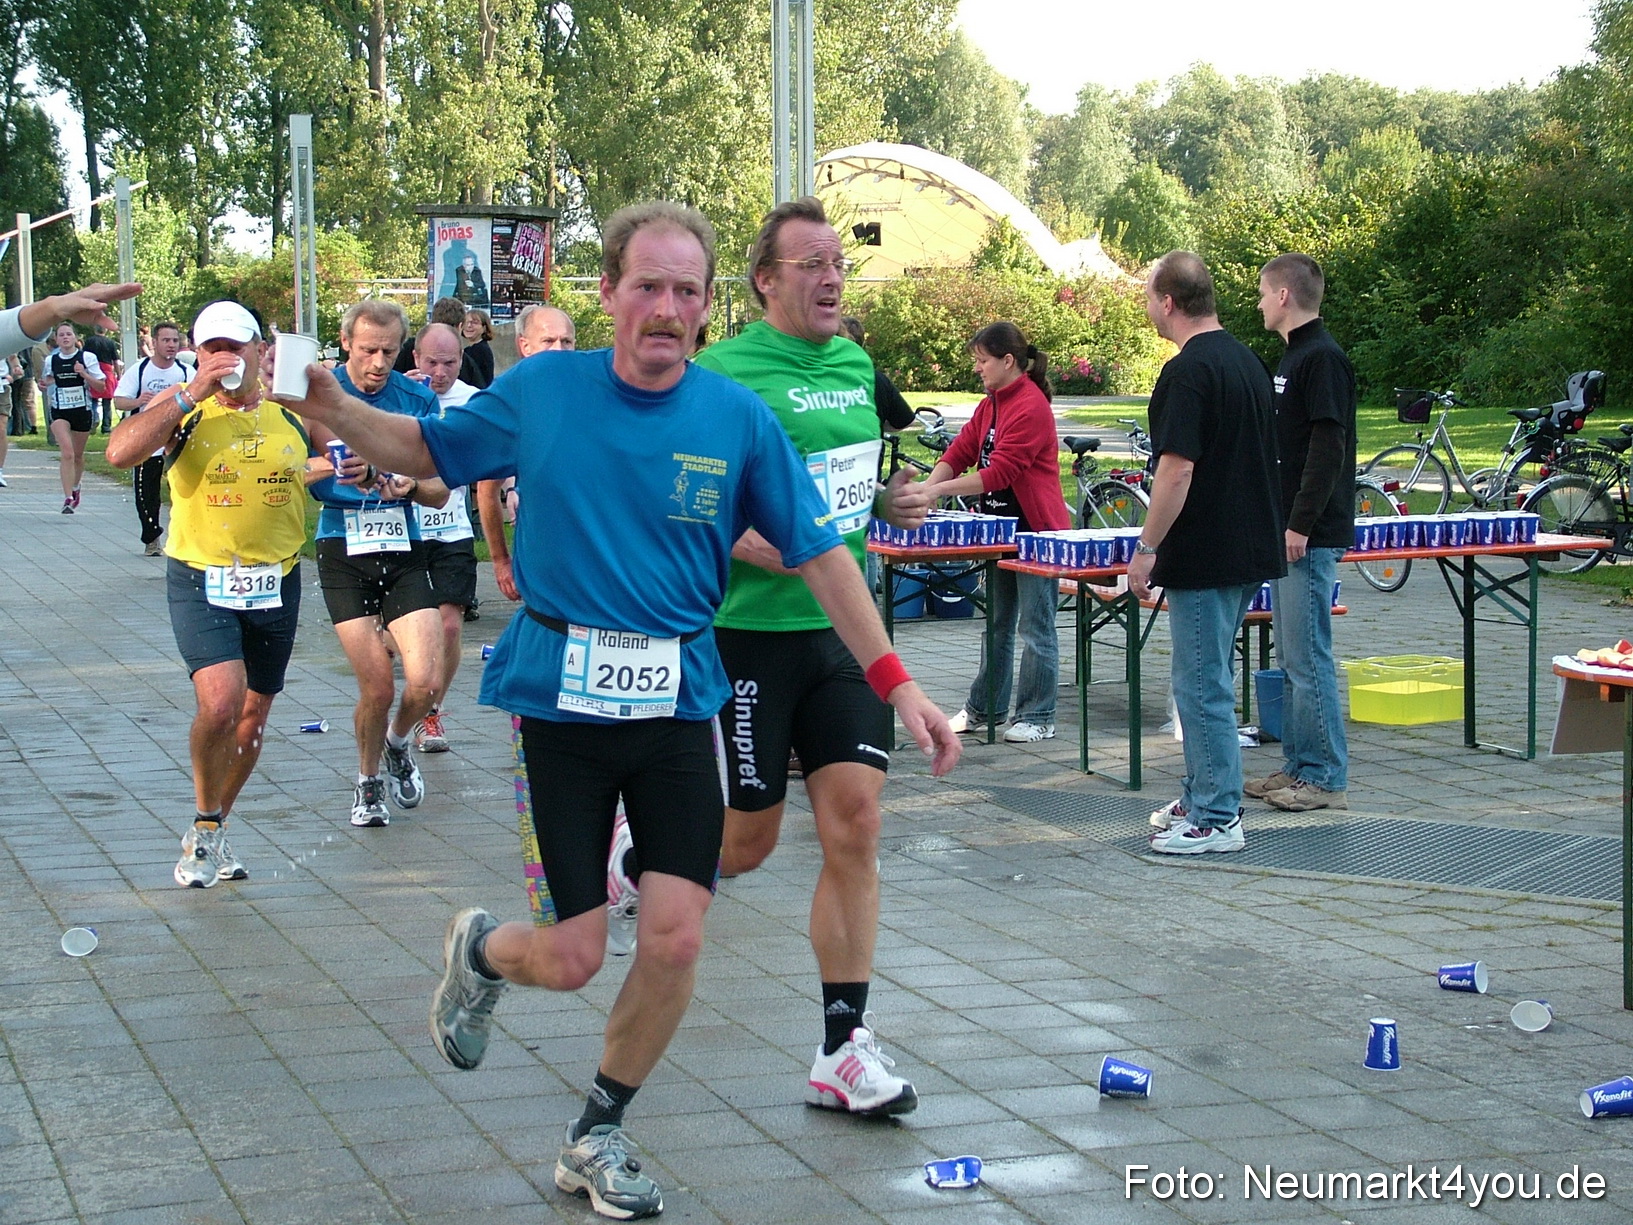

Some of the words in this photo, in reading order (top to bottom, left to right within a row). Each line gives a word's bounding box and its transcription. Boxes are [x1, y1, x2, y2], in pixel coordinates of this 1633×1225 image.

[437, 226, 473, 246] Jonas
[788, 385, 868, 414] Sinupret
[831, 457, 856, 474] Peter
[207, 494, 218, 504] M
[235, 493, 243, 503] S
[836, 478, 873, 510] 2605
[423, 511, 455, 527] 2871
[364, 522, 403, 537] 2736
[597, 629, 650, 650] Roland
[567, 652, 575, 666] A
[595, 663, 670, 692] 2052
[732, 679, 762, 788] Sinupret
[1593, 1090, 1633, 1104] Xenofit
